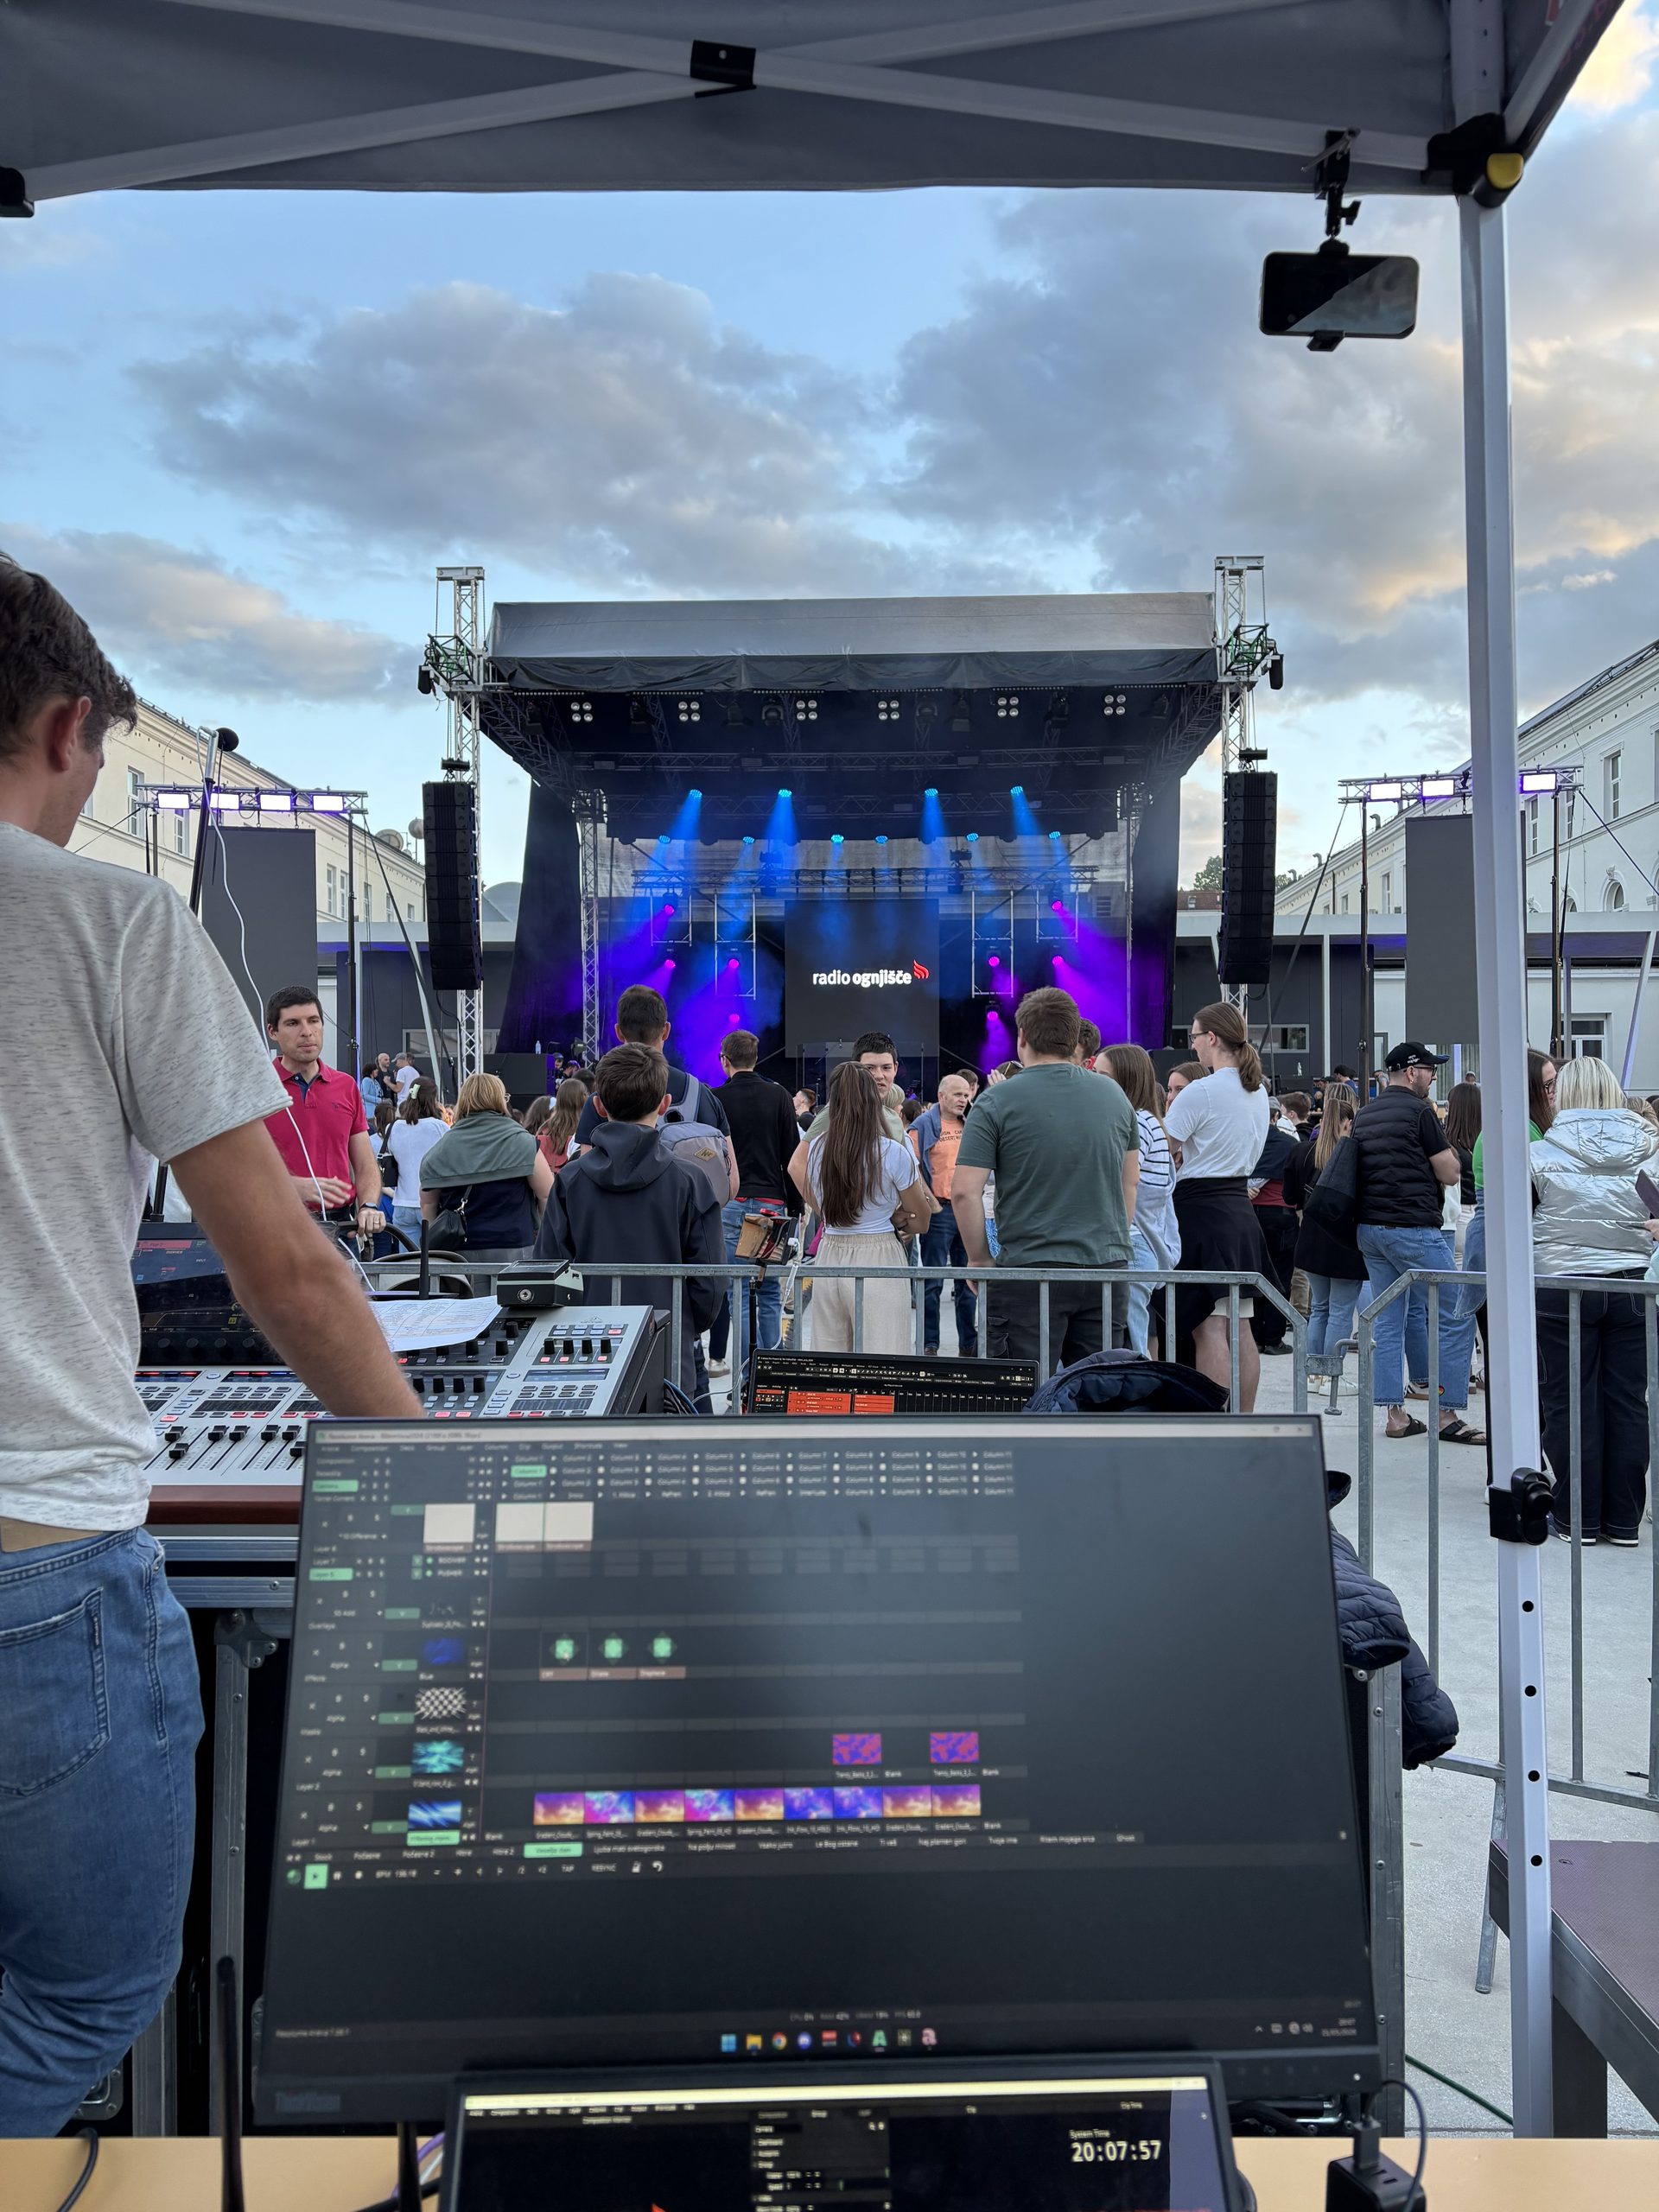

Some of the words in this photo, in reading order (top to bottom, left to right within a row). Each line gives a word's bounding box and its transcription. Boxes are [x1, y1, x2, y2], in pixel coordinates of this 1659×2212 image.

[812, 969, 850, 985] radio
[852, 969, 912, 988] ognjišče
[1070, 2129, 1093, 2140] System
[1094, 2129, 1110, 2138] Time
[1071, 2139, 1161, 2162] 20:07:57
